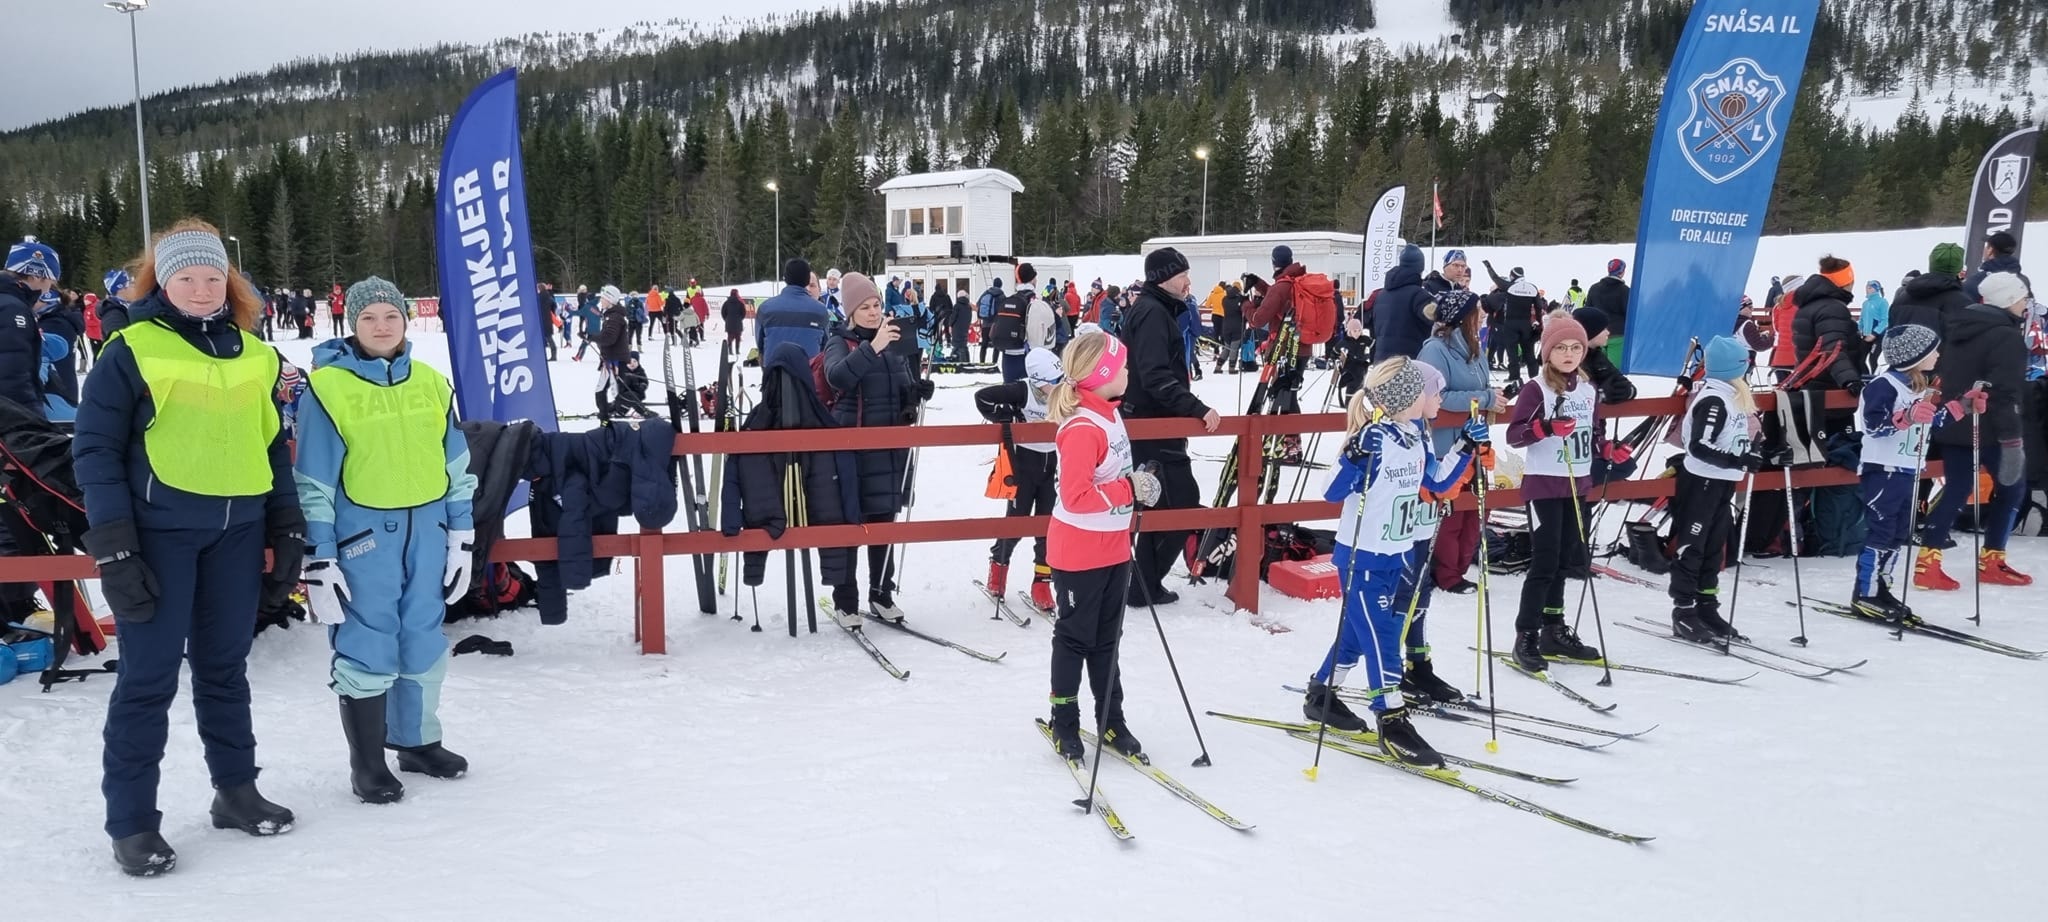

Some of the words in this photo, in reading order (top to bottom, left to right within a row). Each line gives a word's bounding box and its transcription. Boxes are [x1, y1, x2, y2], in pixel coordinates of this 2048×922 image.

[1703, 8, 1775, 33] SNÅSA
[1780, 15, 1801, 34] IL
[1705, 65, 1769, 104] SNÅSA
[1708, 153, 1736, 164] 1902
[1671, 208, 1749, 227] IDRETTSGLEDE
[1375, 223, 1384, 233] IL
[1679, 228, 1702, 243] FOR
[1702, 230, 1733, 245] ALLE!
[1384, 220, 1396, 271] NGRENN
[1371, 239, 1383, 281] GRONG
[453, 168, 501, 404] TEINKJER
[1570, 430, 1590, 460] 18
[1897, 442, 1906, 455] 2
[1556, 449, 1564, 464] 2
[1381, 523, 1390, 541] 2
[344, 538, 377, 560] RAVEN
